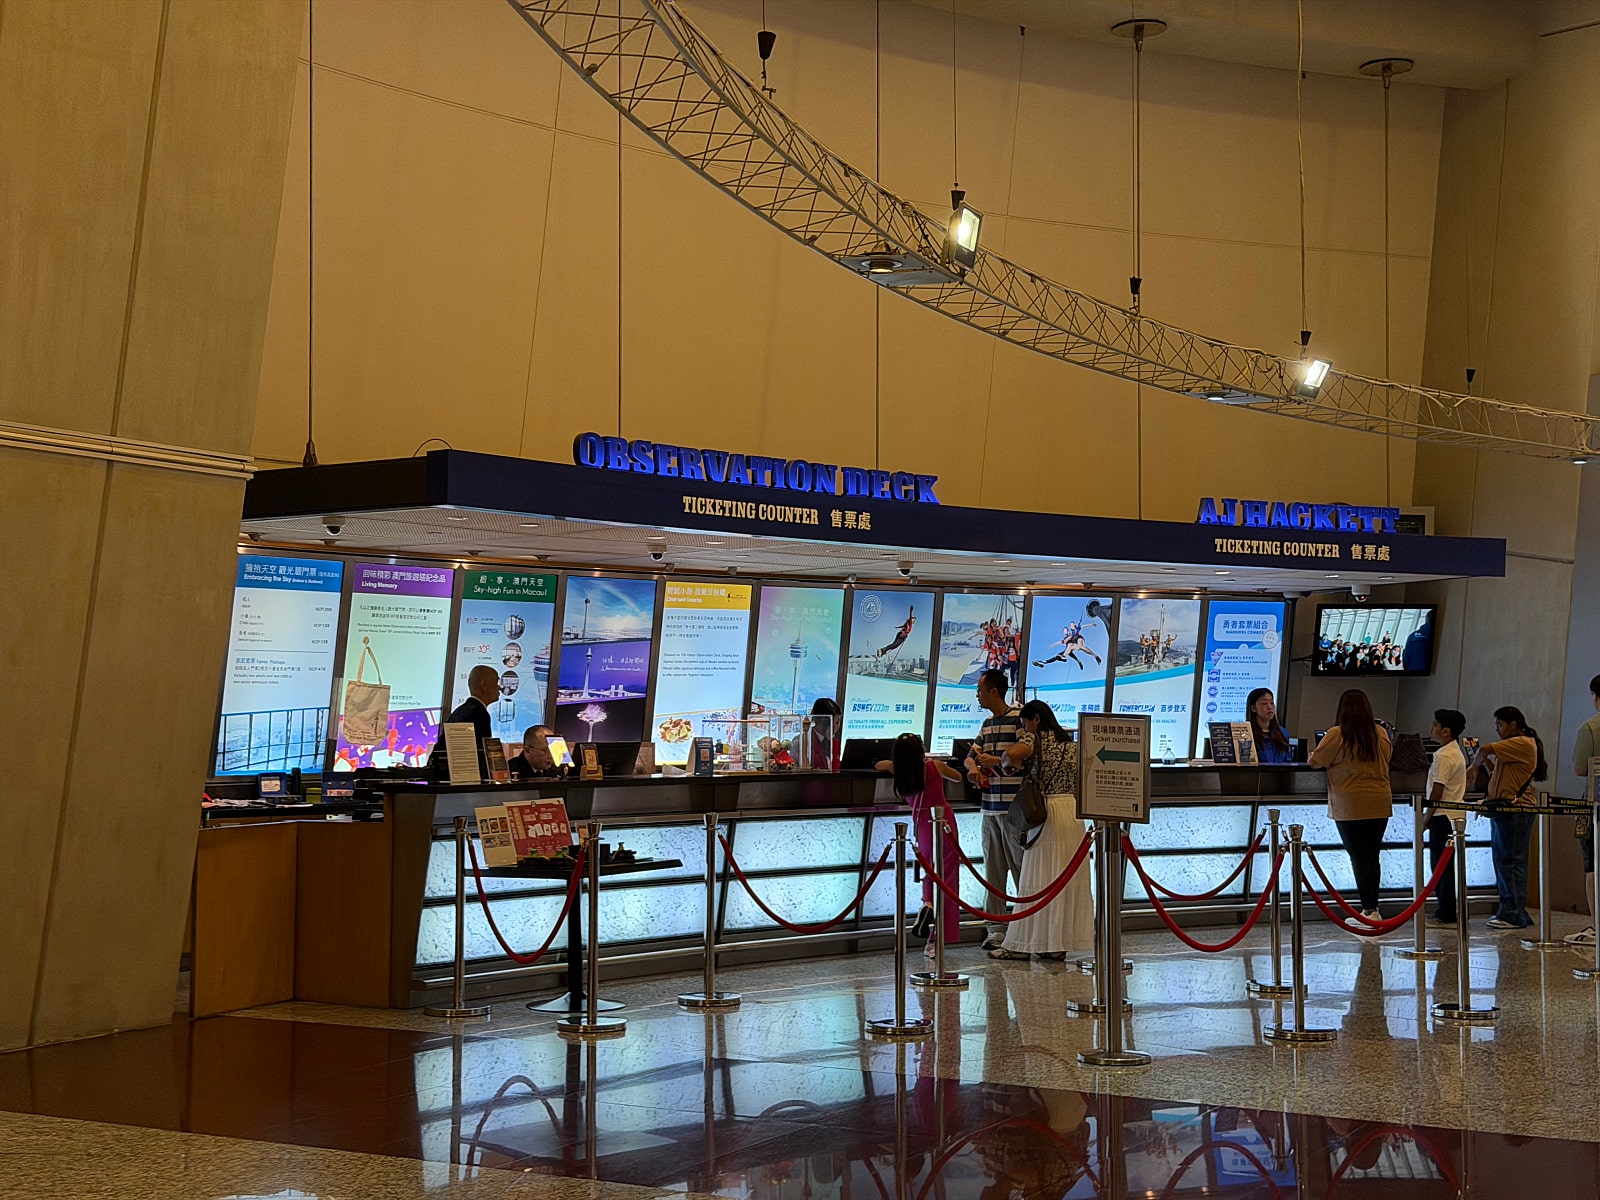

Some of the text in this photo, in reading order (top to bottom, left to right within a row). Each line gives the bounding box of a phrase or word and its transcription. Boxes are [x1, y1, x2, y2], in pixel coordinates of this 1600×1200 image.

[573, 431, 940, 504] OBSERVATION DECK
[682, 495, 819, 526] TICKETING COUNTER
[1198, 497, 1400, 533] AJ HACKETT
[829, 508, 872, 531] 售票處
[1214, 538, 1341, 558] TICKETING COUNTER
[1350, 543, 1391, 562] 售票處
[243, 573, 272, 582] Embracing
[282, 576, 291, 584] Sky
[361, 581, 398, 590] Living Memory
[473, 585, 501, 595] Sky-high
[940, 704, 971, 712] SKYWALK
[1160, 704, 1187, 712] 百步登天
[1092, 724, 1141, 736] 現場購票通道
[1092, 734, 1111, 742] Ticket
